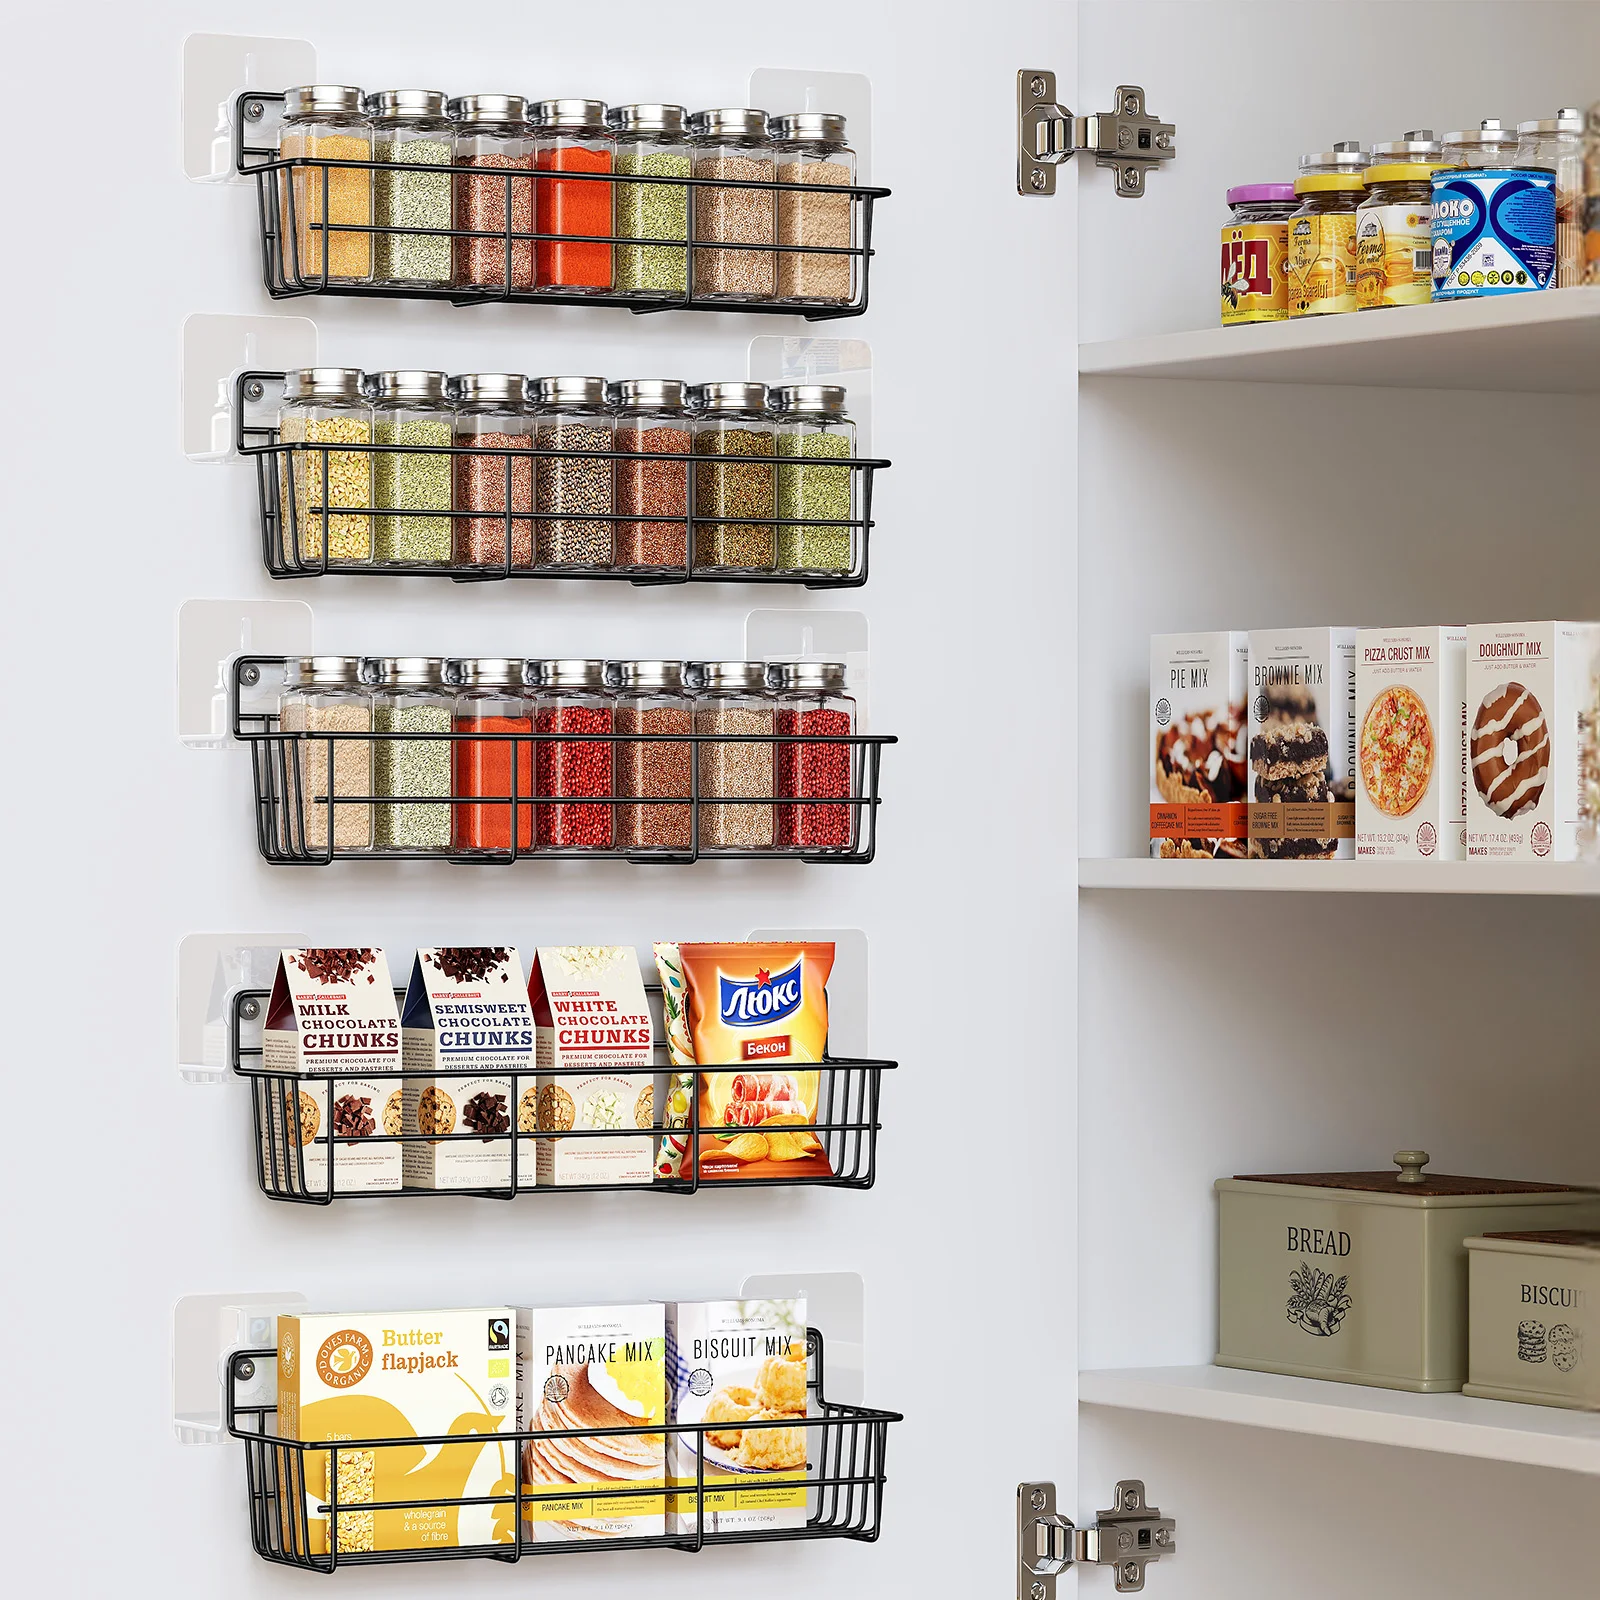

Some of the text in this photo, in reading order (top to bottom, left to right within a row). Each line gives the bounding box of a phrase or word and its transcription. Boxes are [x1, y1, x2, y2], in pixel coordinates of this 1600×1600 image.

[1364, 646, 1430, 661] PIZZA CRUST MIX
[1480, 642, 1541, 657] DOUGHNUT MIX
[1171, 668, 1208, 688] PIE MIX
[1255, 664, 1323, 686] BROWNIE MIX
[1357, 847, 1376, 855] MAKES
[1469, 847, 1488, 855] MAKES
[299, 1004, 350, 1016] MILK
[435, 1004, 527, 1014] SEMISWEET
[554, 1000, 618, 1012] WHITE
[302, 1019, 398, 1030] CHOCOLATE
[438, 1017, 531, 1027] CHOCOLATE
[558, 1016, 649, 1026] CHOCOLATE
[303, 1033, 399, 1049] CHUNKS
[440, 1031, 532, 1046] CHUNKS
[559, 1029, 650, 1045] CHUNKS
[747, 1042, 786, 1055] Бекон
[495, 1079, 512, 1089] BAKIN
[1287, 1226, 1351, 1256] BREAD
[382, 1329, 443, 1346] Butter
[320, 1333, 369, 1369] DOVES FARM
[546, 1341, 653, 1365] PANCAKE MIX
[694, 1335, 792, 1360] BISCUIT MIX
[382, 1351, 458, 1374] flapjack
[325, 1359, 370, 1385] ORGANIC
[326, 1432, 352, 1442] 5 bars
[688, 1496, 711, 1504] BISUIT
[541, 1502, 583, 1512] PANCAKE MIX
[404, 1509, 447, 1520] wholegrain
[404, 1522, 410, 1531] &
[419, 1522, 446, 1531] source
[421, 1532, 448, 1541] of fibre
